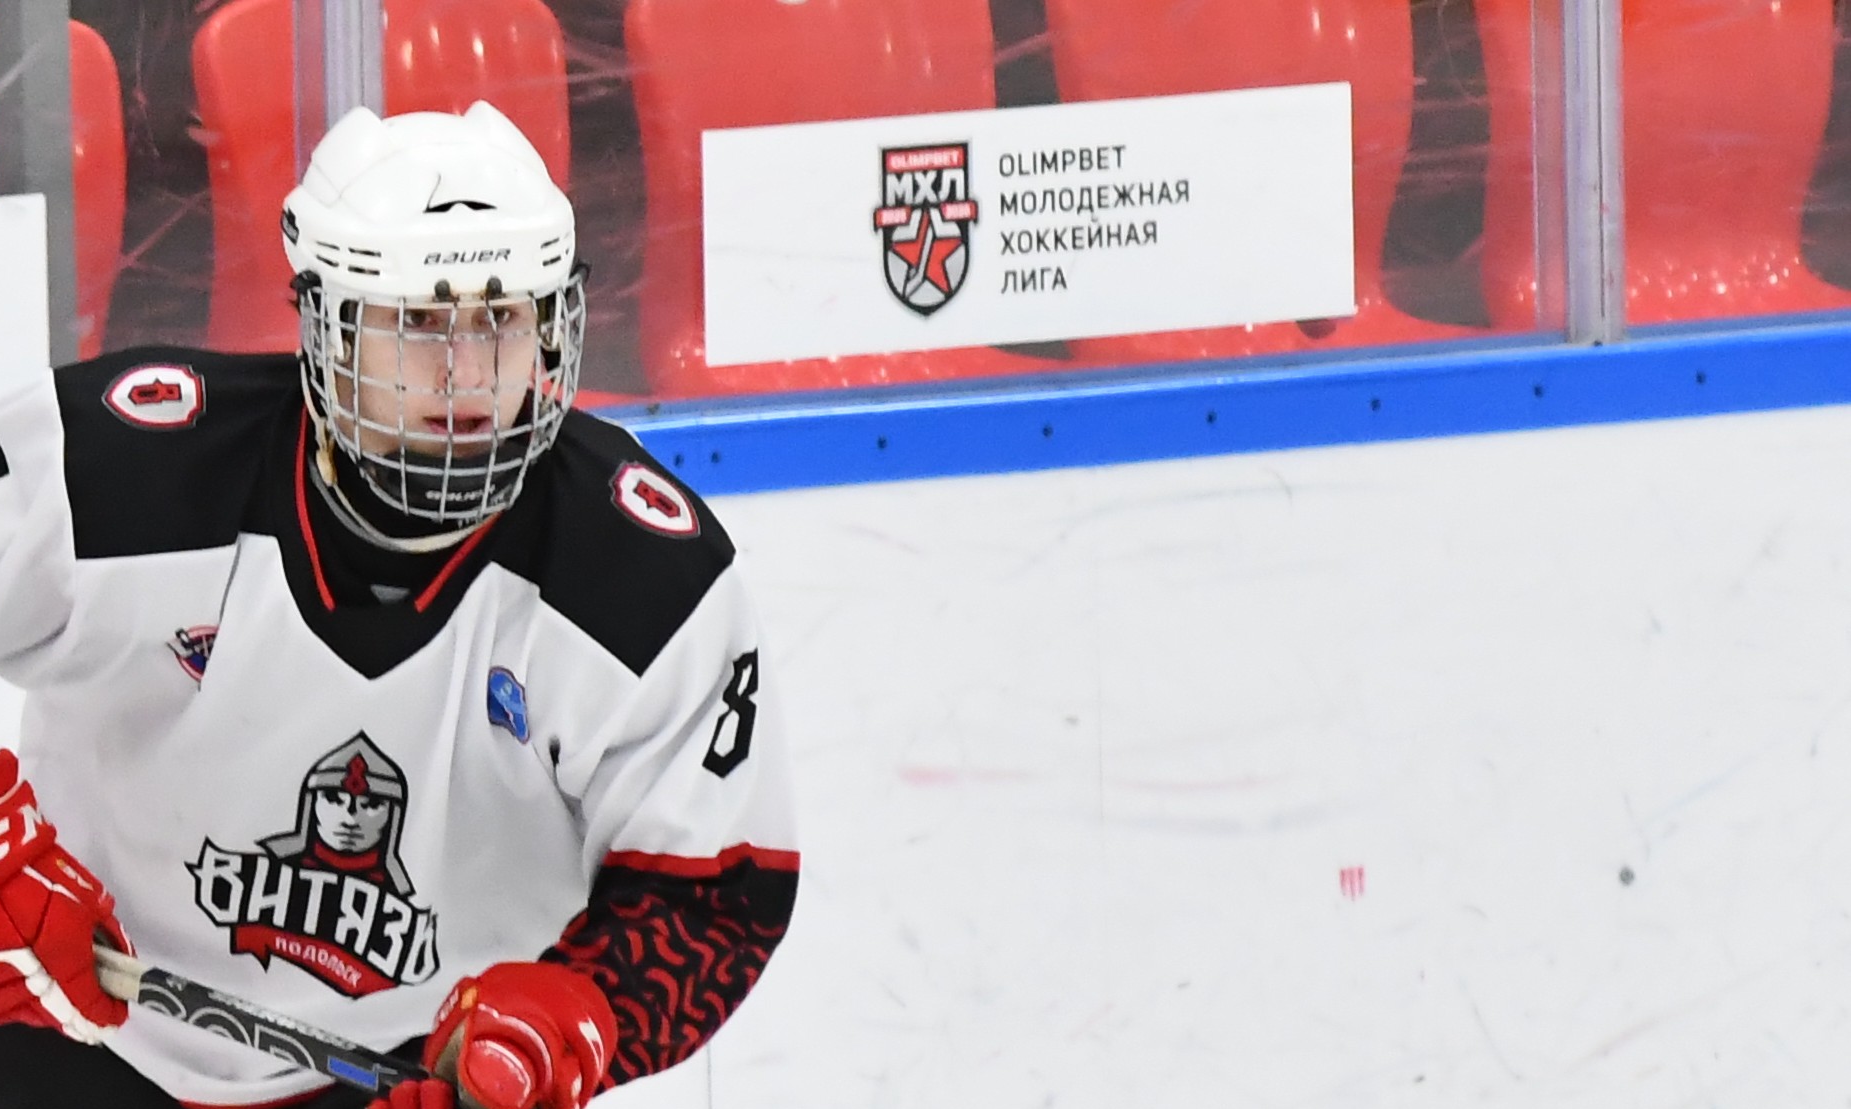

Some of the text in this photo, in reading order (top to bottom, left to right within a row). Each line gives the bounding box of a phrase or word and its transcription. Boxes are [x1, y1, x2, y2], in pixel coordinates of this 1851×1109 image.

[998, 145, 1126, 178] OLIMPBET
[886, 168, 965, 206] МХЛ
[1000, 179, 1191, 216] МОЛОДЕЖНАЯ
[1000, 217, 1158, 255] ХОККЕЙНАЯ
[423, 248, 511, 266] BAUER
[1001, 266, 1068, 294] ЛИГА
[701, 646, 759, 779] 8
[274, 935, 362, 988] ПОДОЛЬСК
